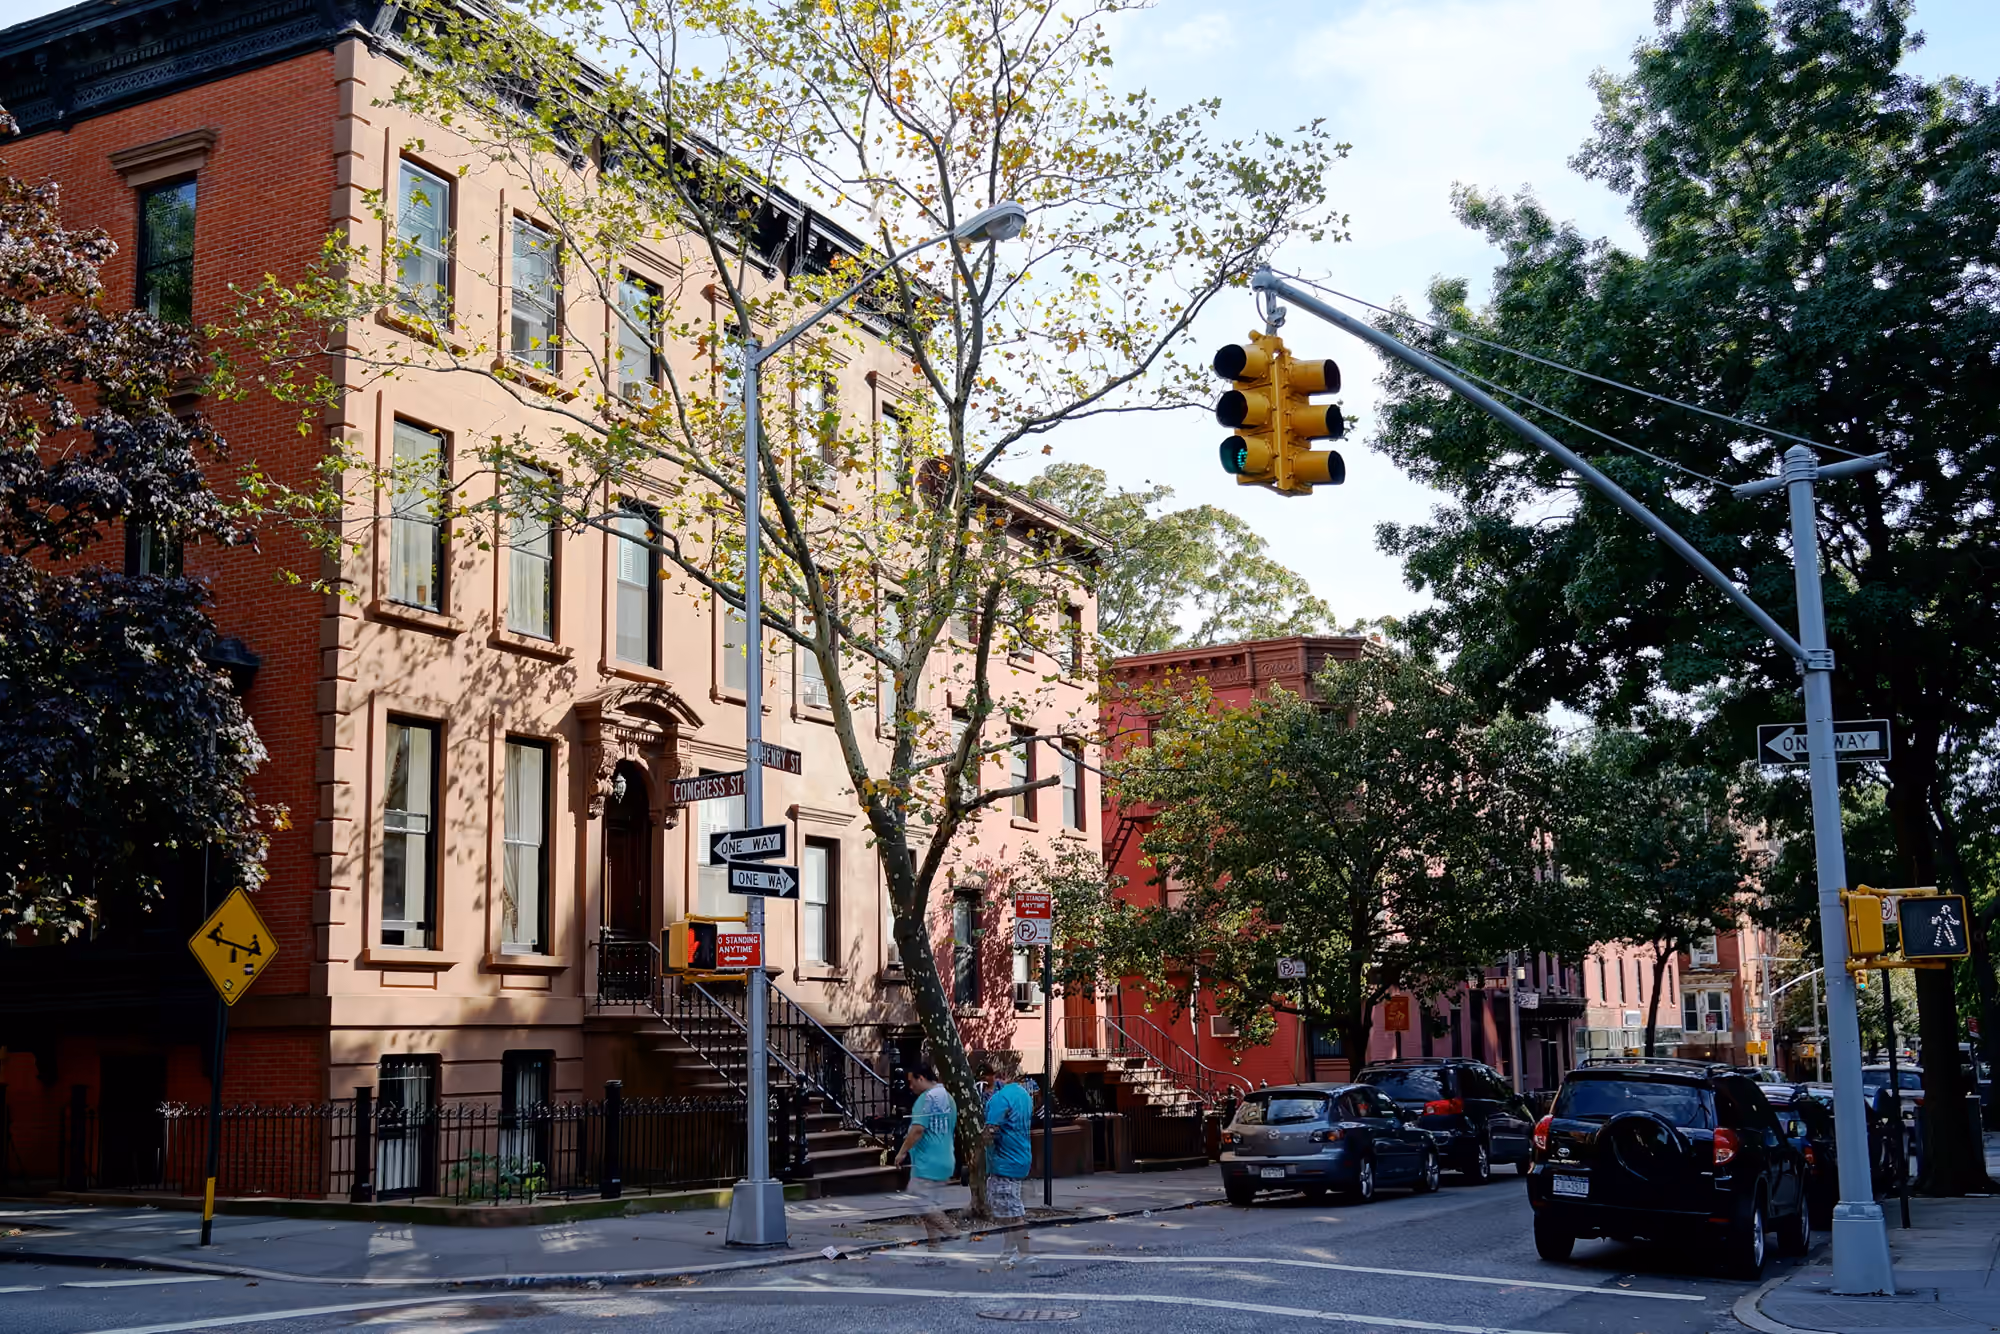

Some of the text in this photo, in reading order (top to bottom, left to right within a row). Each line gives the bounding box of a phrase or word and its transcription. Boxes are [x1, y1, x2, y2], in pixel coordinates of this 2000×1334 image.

[1783, 733, 1870, 752] ON WAY
[761, 745, 800, 773] HENRY ST
[673, 774, 743, 803] CONGRESS ST
[721, 835, 776, 855] ONE WAY
[738, 872, 789, 889] ONE WAY
[719, 945, 753, 953] ANYTIME
[725, 936, 758, 945] STANDING
